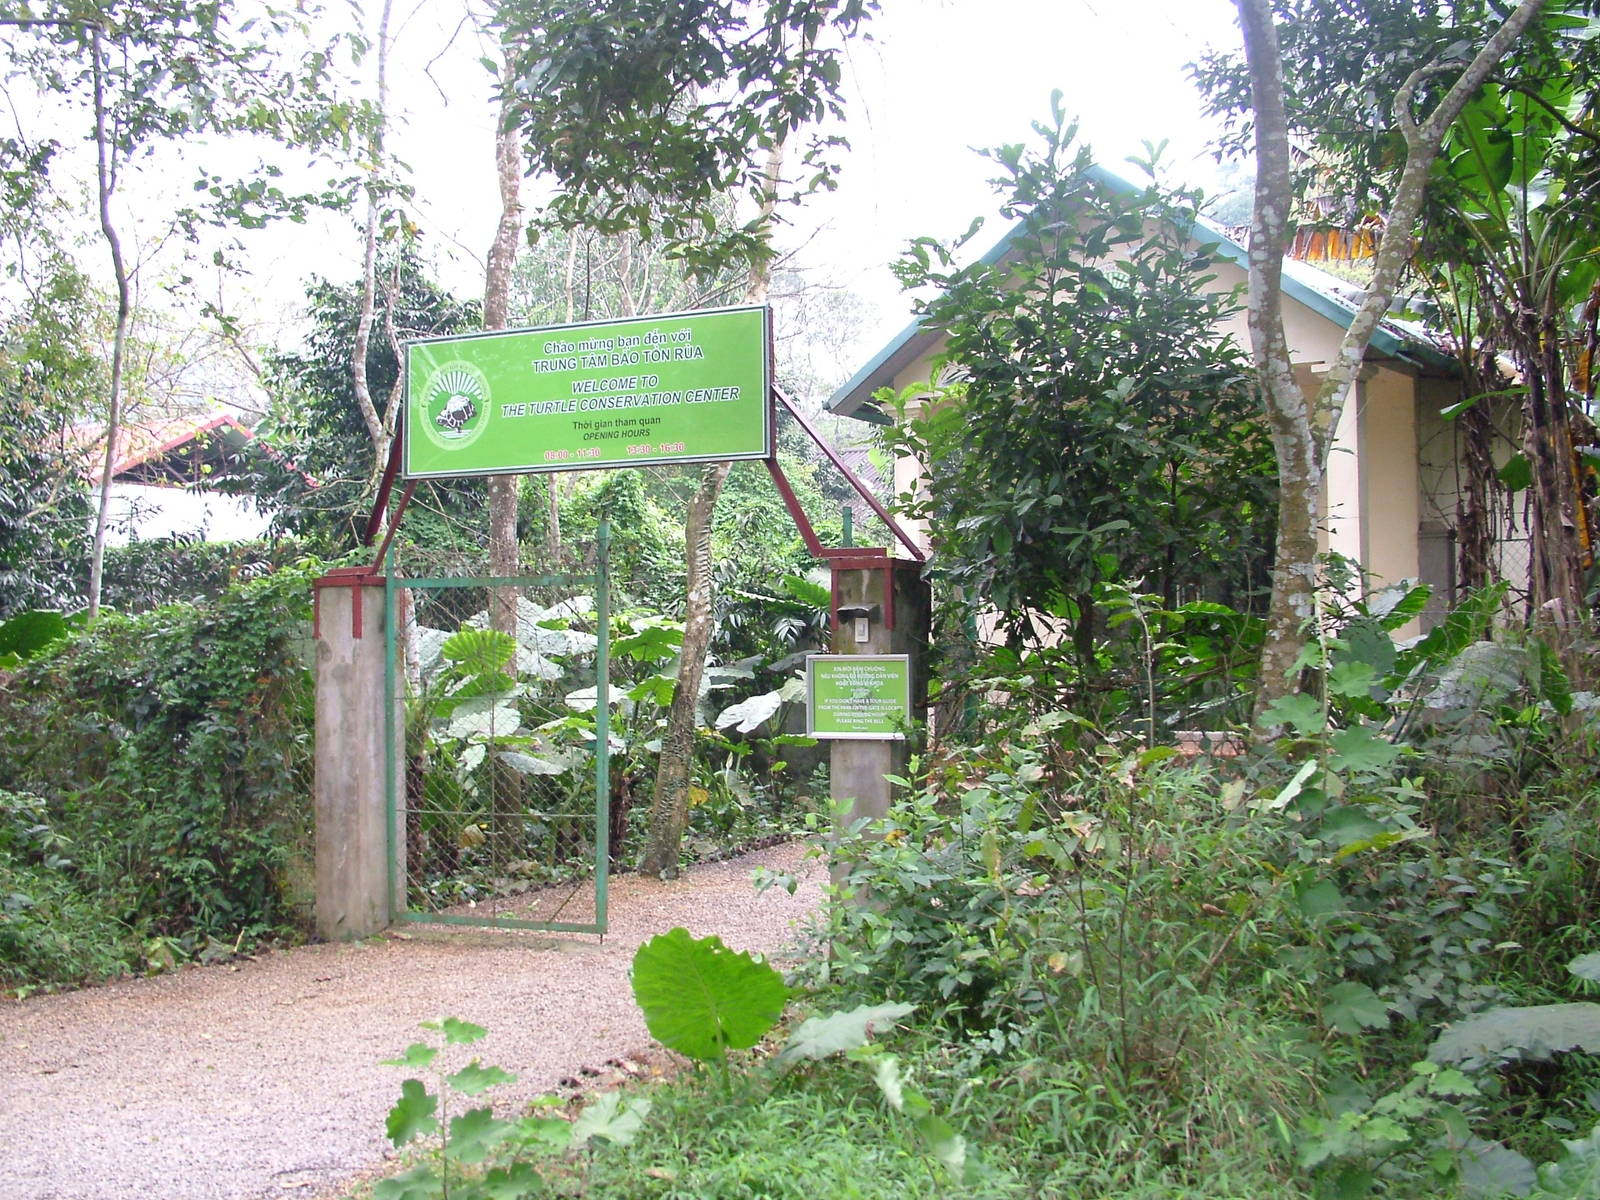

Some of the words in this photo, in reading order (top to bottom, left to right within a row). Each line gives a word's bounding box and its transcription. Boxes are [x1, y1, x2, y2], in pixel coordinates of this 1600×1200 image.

[534, 357, 576, 373] TRUNG
[581, 353, 607, 369] TÂM
[572, 376, 637, 394] WELCOME
[641, 375, 658, 388] TO
[502, 403, 525, 418] THE
[529, 399, 576, 415] TURTLE
[580, 391, 681, 411] CONSERVATION
[684, 387, 740, 403] CENTER
[594, 420, 613, 431] gian
[615, 418, 637, 428] tham
[639, 417, 661, 427] quan
[583, 430, 619, 441] OPENING
[621, 428, 651, 438] HOURS
[660, 442, 684, 453] 16:30
